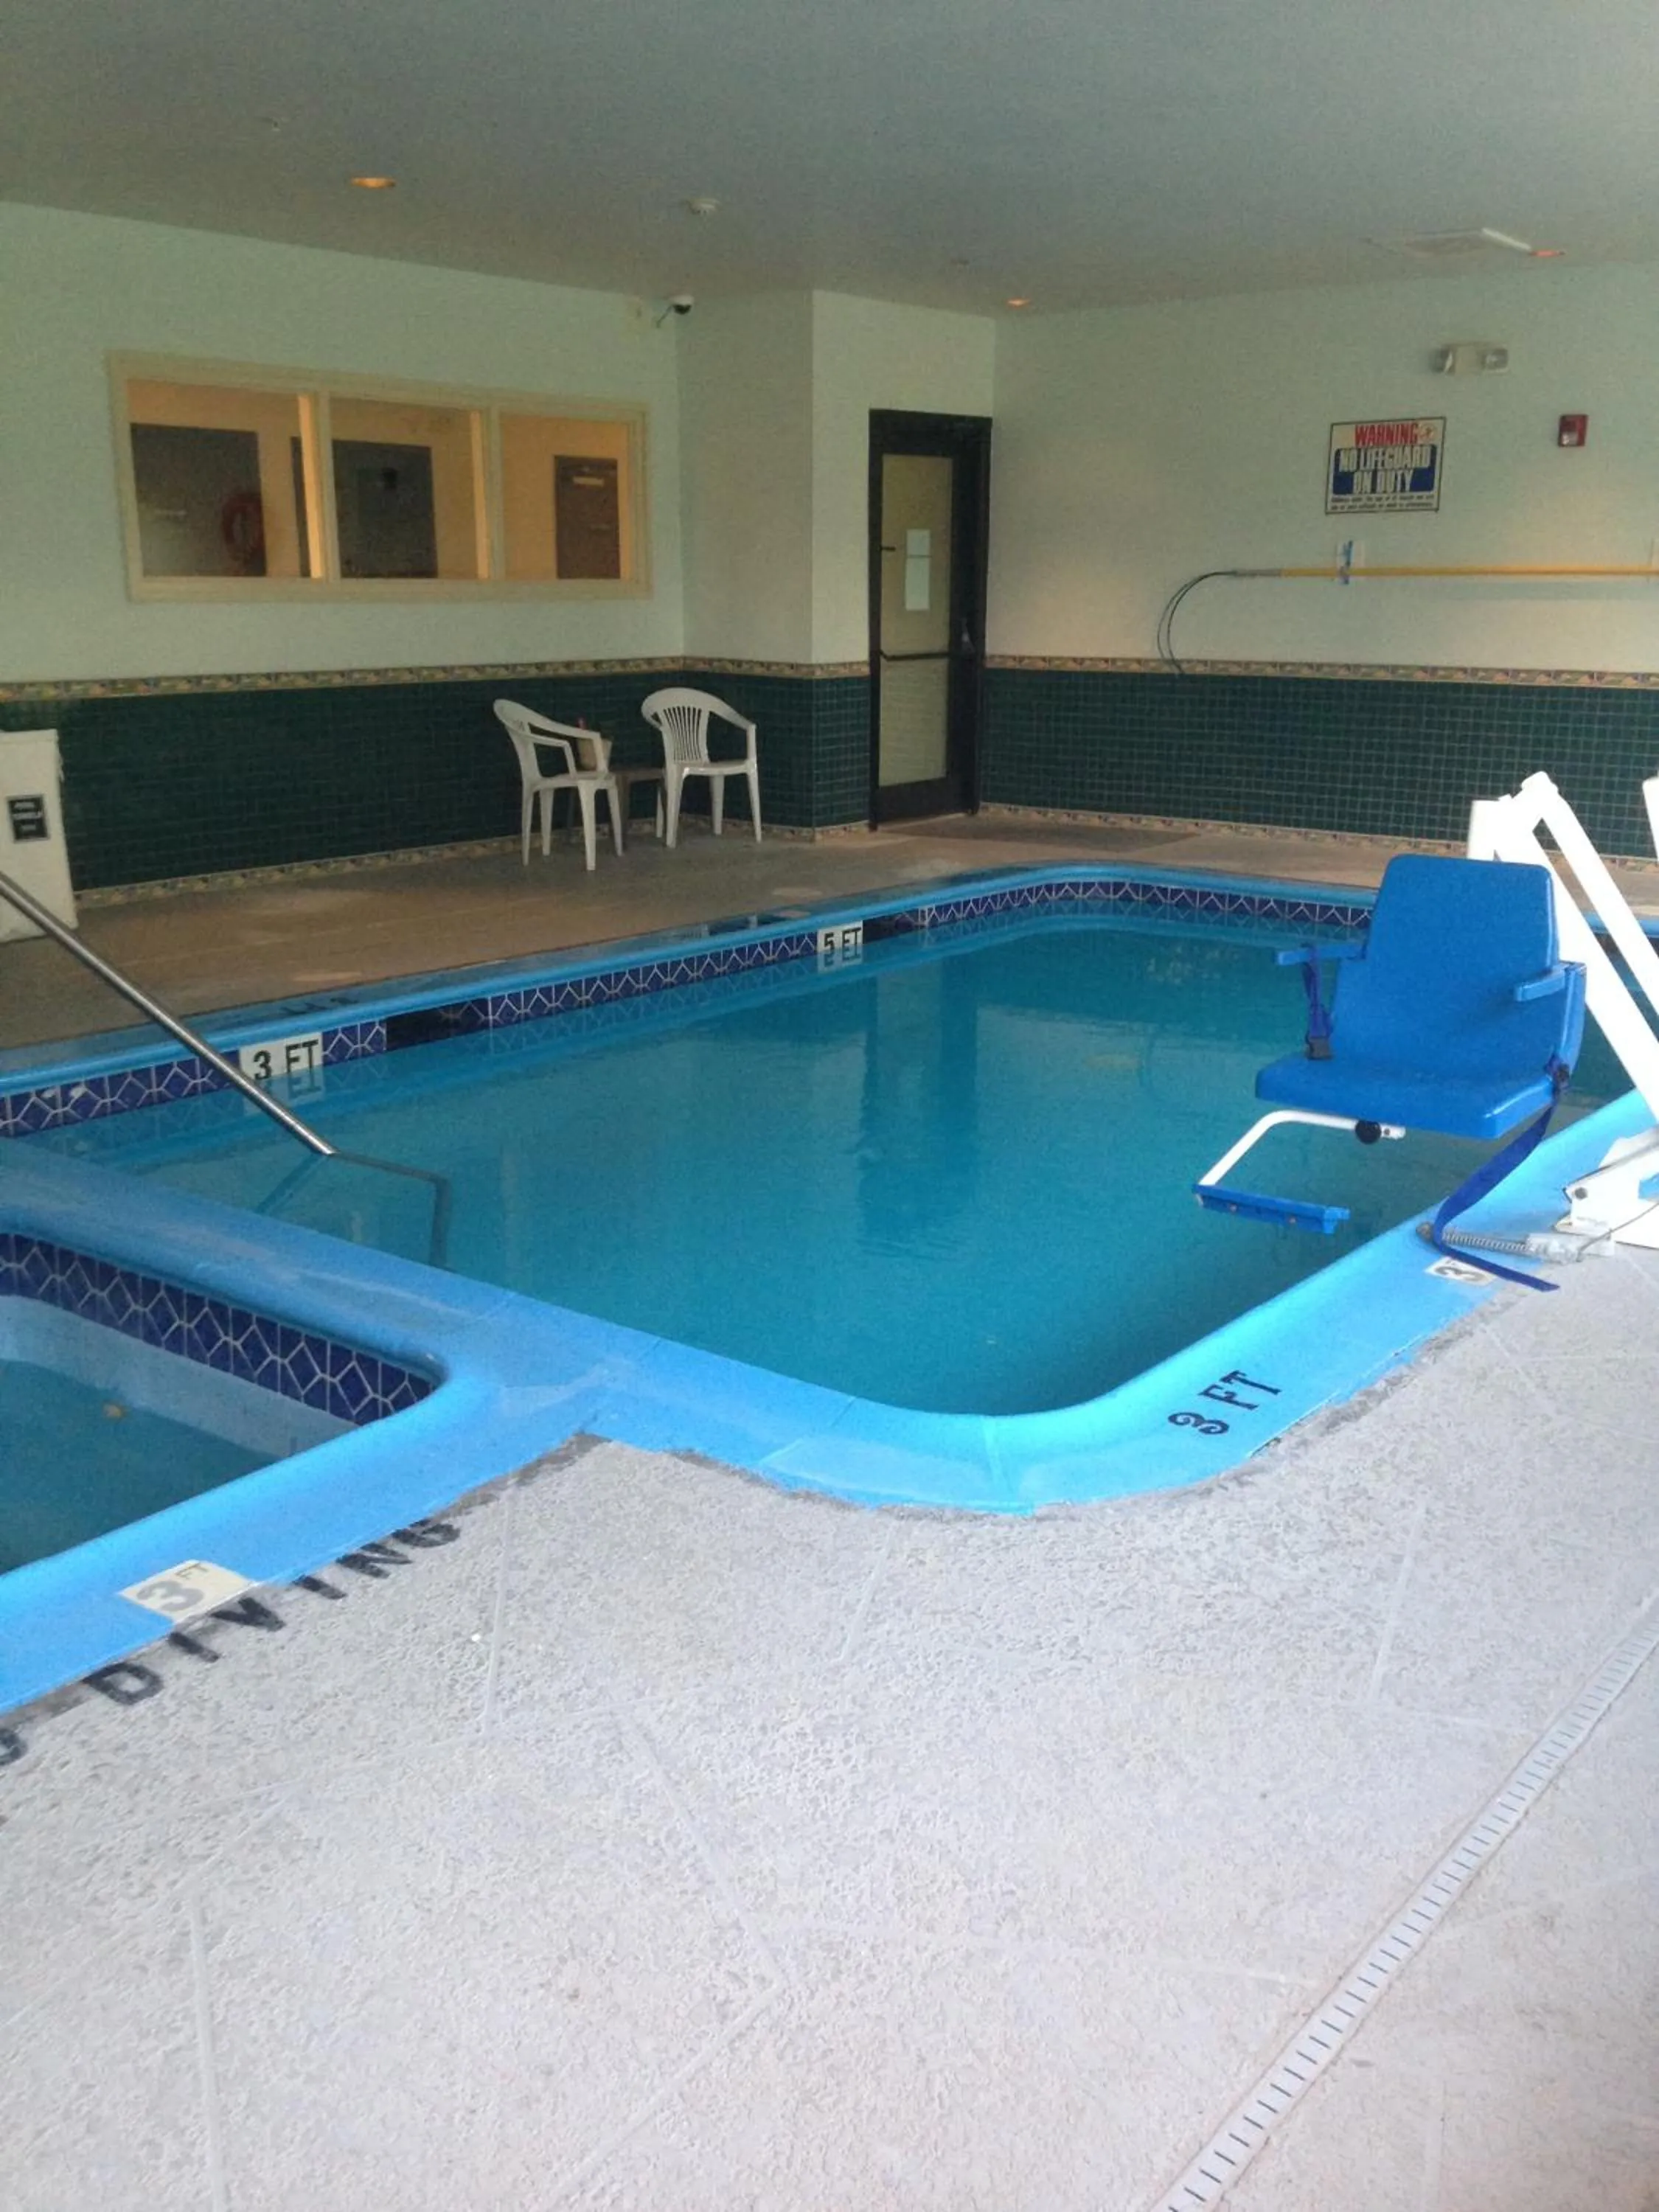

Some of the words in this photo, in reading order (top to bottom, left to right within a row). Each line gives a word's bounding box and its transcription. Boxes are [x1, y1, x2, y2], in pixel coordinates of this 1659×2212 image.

[1354, 422, 1419, 448] WARNING
[1338, 448, 1357, 473] NO
[1359, 444, 1432, 470] LIFEGUARD
[1352, 470, 1373, 495] ON
[1375, 467, 1416, 493] DUTY
[824, 933, 834, 950] 5
[842, 927, 862, 945] FT
[253, 1050, 272, 1081] 3
[285, 1038, 319, 1073] FT
[1433, 1265, 1488, 1281] 3
[1197, 1370, 1282, 1411] FT
[1168, 1411, 1230, 1435] 3
[136, 1580, 206, 1612] 3
[83, 1518, 461, 1705] DIVING
